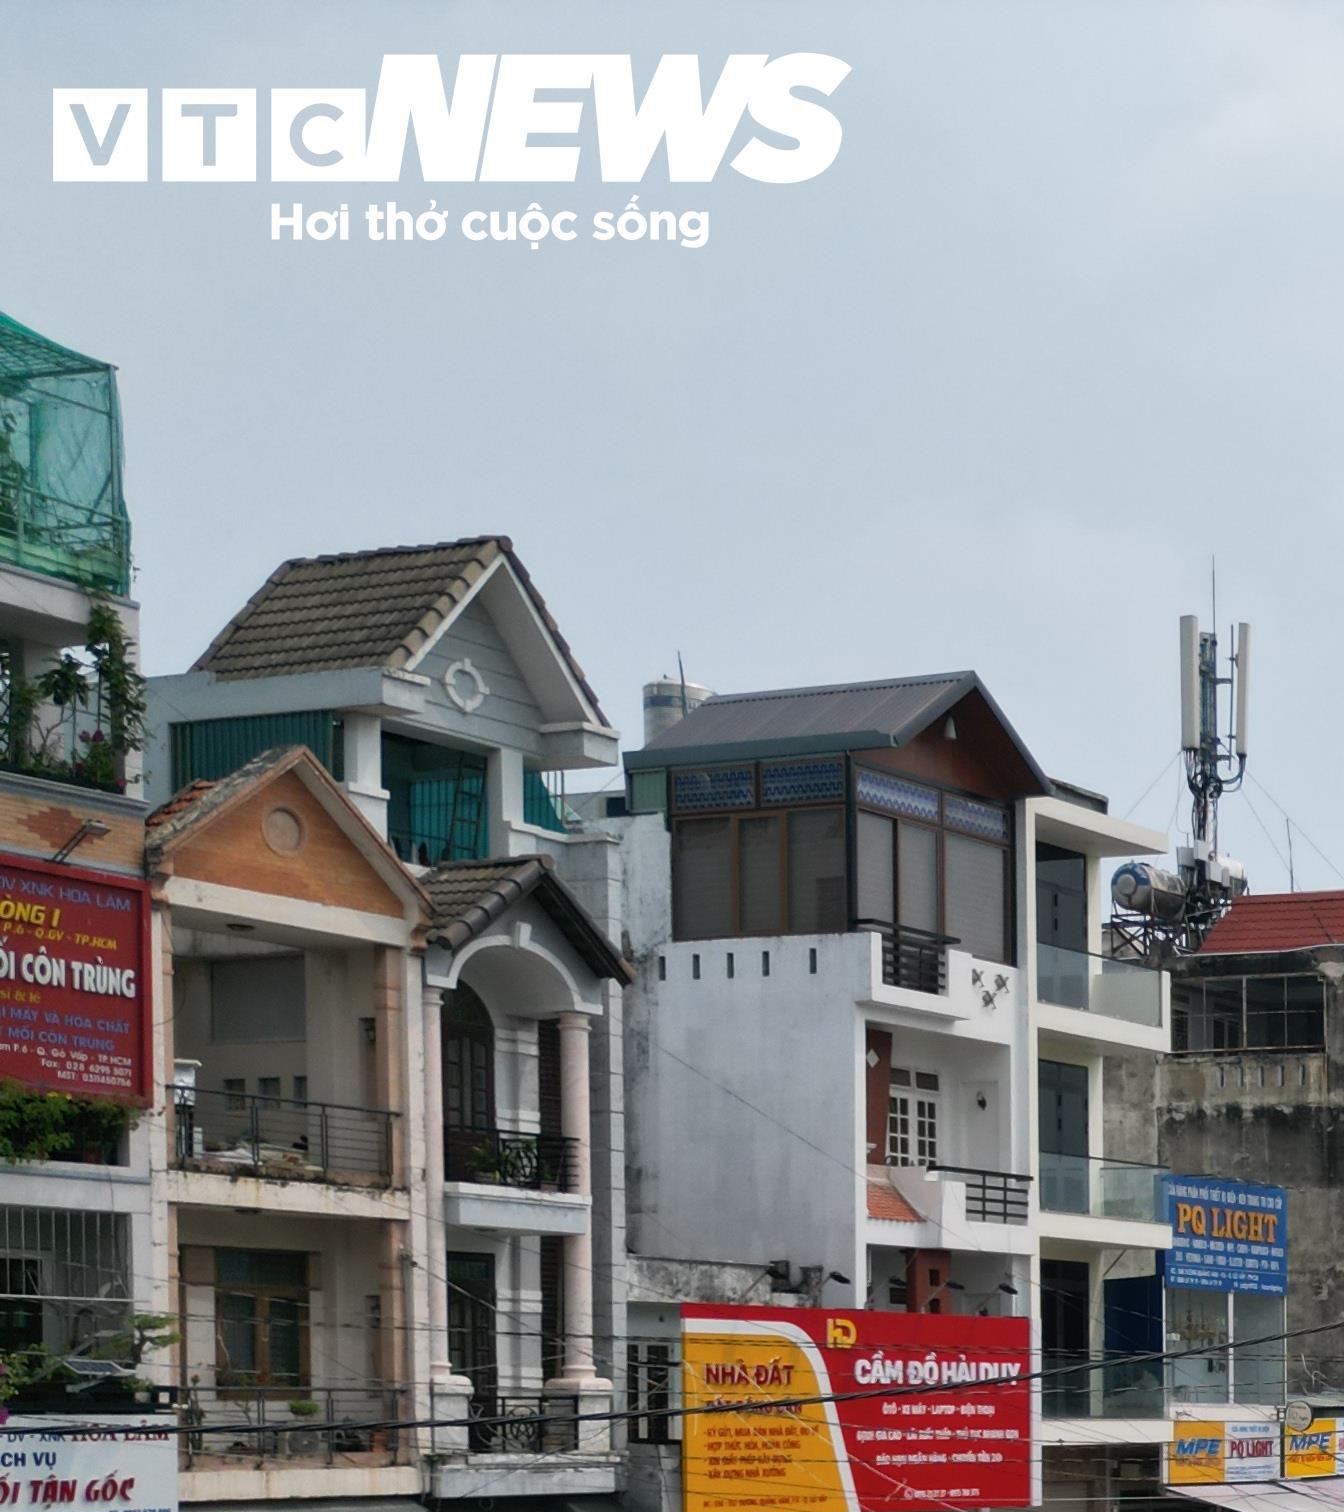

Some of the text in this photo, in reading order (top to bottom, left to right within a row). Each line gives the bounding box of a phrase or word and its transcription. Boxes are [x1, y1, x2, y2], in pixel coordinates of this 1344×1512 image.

[22, 881, 54, 896] XNK
[22, 945, 66, 990] CÔN
[71, 955, 136, 998] TRÙNG
[1177, 1203, 1277, 1243] PQ LIGHT
[705, 1356, 795, 1386] NHÀ ĐẤT
[854, 1350, 904, 1385] CẦM
[907, 1352, 939, 1385] ĐỒ
[941, 1354, 977, 1384] HẢI
[1176, 1438, 1219, 1456] MPE
[1231, 1440, 1274, 1458] PQ LIGHT
[1289, 1432, 1331, 1452] MPE
[33, 1452, 57, 1470] VỤ
[30, 1474, 78, 1509] TẬN
[85, 1469, 135, 1502] GỐC
